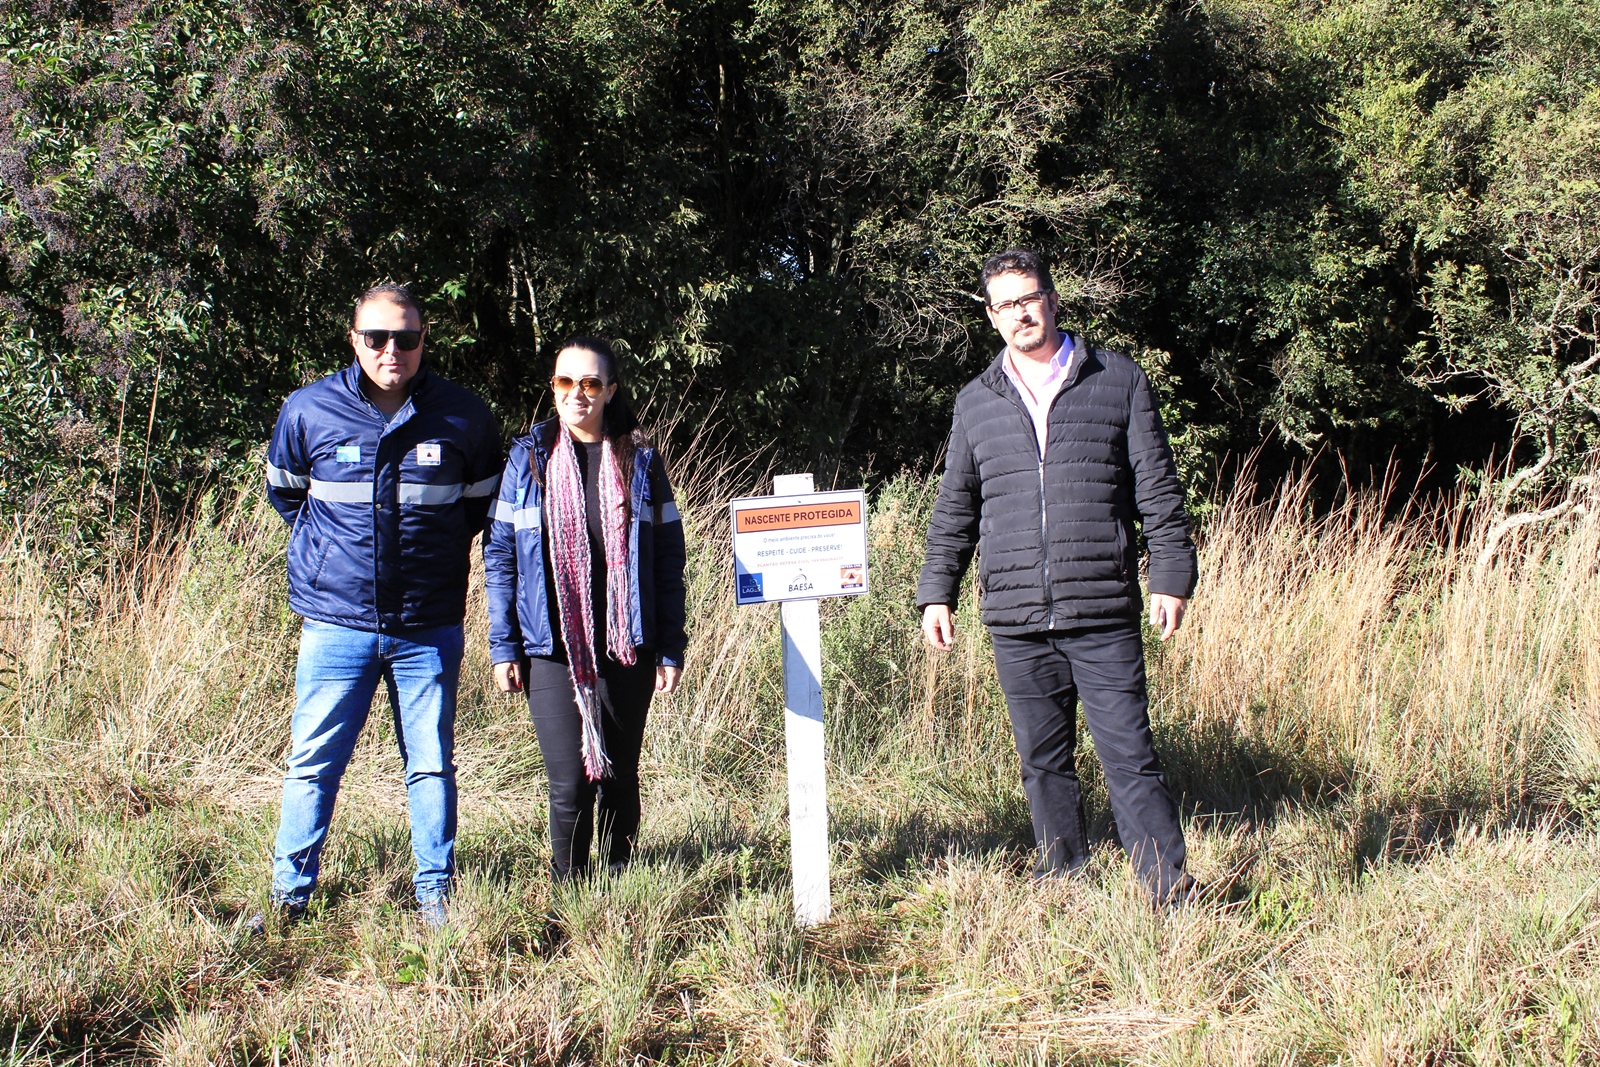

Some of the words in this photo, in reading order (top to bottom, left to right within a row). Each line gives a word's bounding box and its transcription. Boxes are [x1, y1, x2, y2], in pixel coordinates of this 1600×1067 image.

[744, 513, 791, 525] NASCENTE
[793, 508, 853, 521] PROTEGIDA
[757, 549, 784, 557] RESPEITE
[789, 547, 806, 555] CUIDE
[811, 544, 843, 552] PRESERVE!
[788, 583, 814, 592] BAESA
